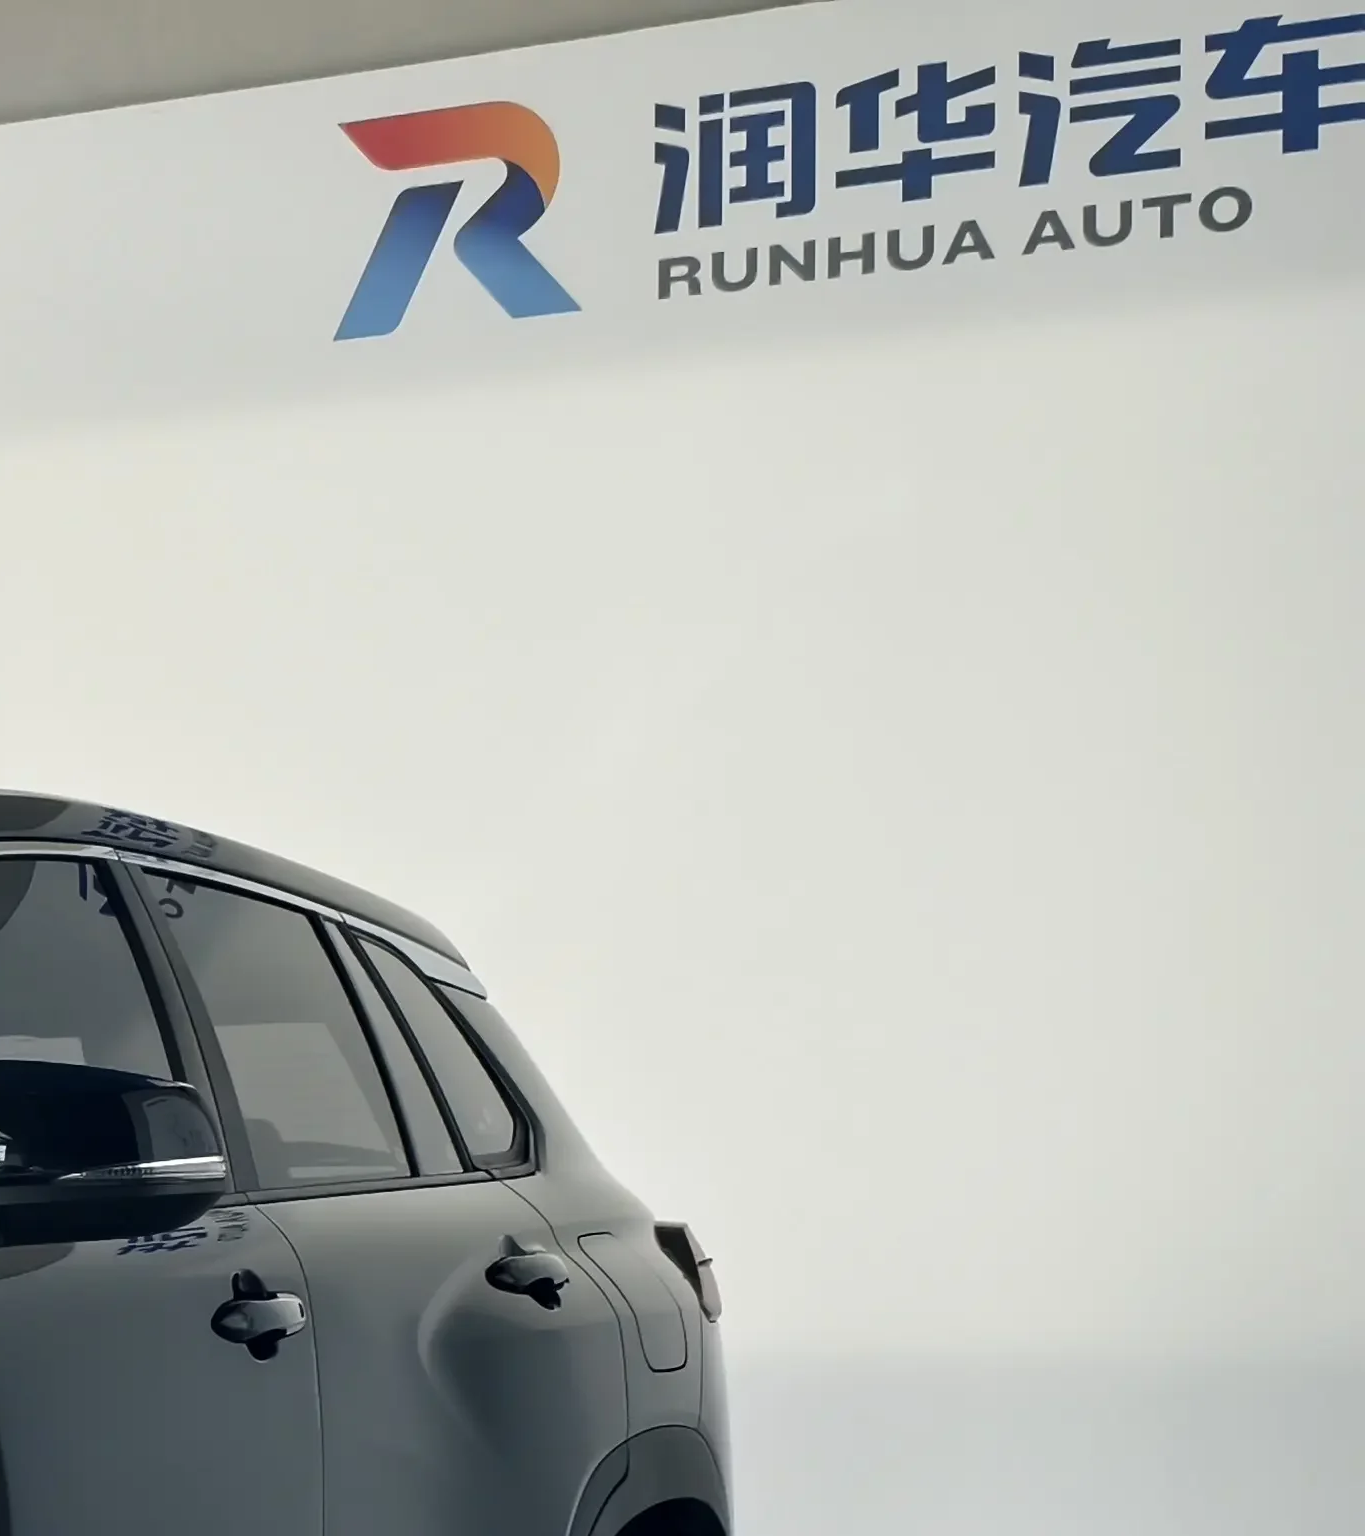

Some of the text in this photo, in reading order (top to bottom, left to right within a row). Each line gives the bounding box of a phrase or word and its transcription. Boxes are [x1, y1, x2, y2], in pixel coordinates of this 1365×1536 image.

[654, 14, 1365, 234] 润华汽车
[658, 186, 1253, 300] RUNHUA AUTO
